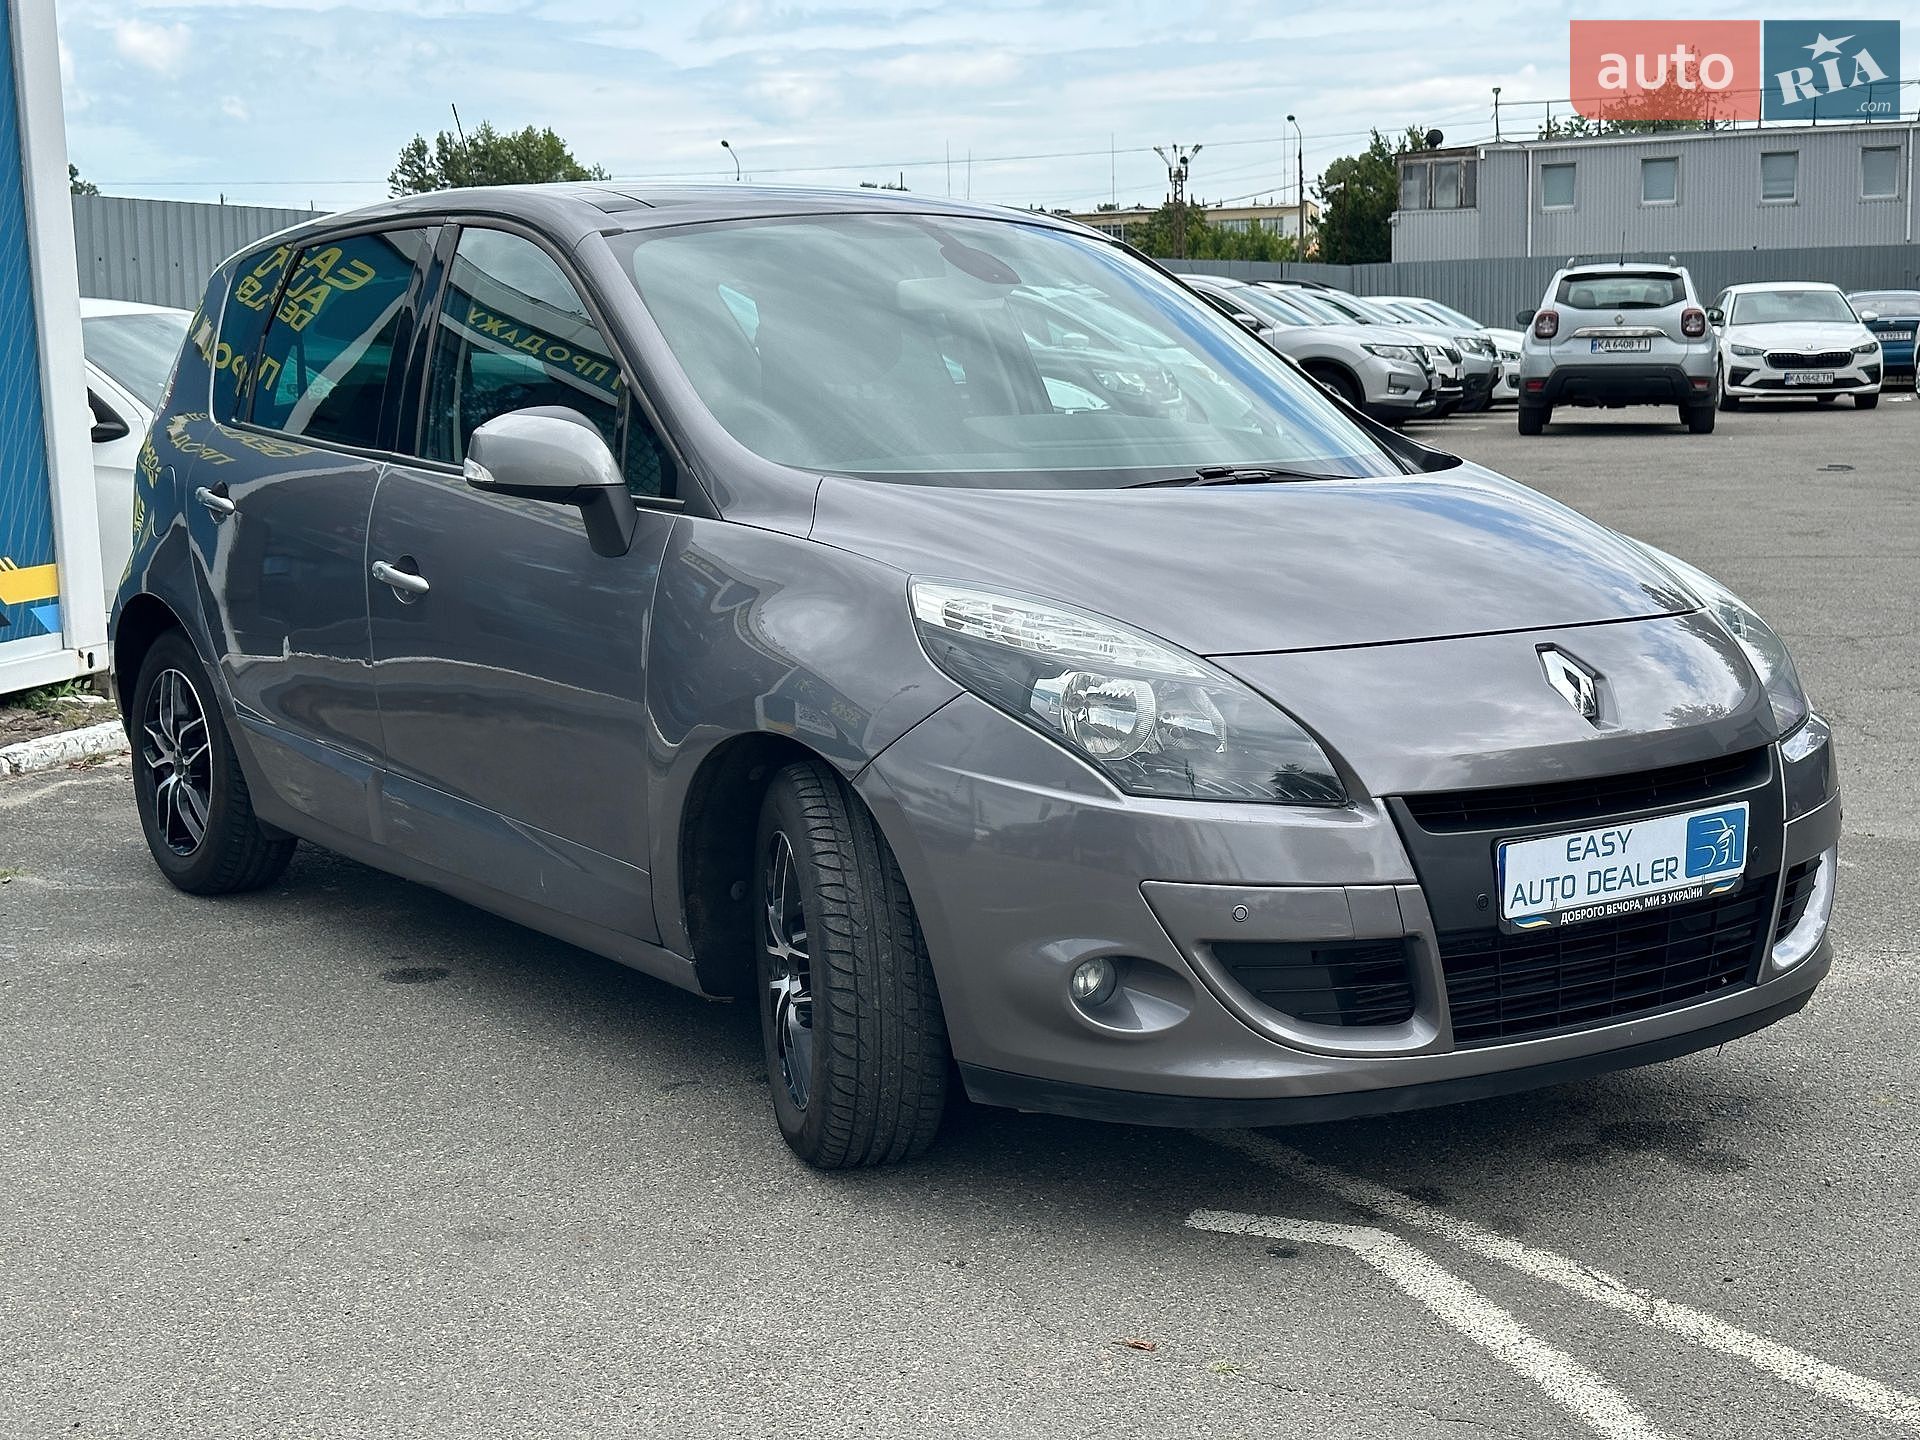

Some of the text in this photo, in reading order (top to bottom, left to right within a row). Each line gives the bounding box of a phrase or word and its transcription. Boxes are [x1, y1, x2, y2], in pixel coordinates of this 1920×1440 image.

[1566, 829, 1633, 862] EASY
[1510, 856, 1679, 909] AUTO DEALER
[1560, 905, 1605, 925] ДОБРОГО
[1606, 899, 1643, 914] ВЕЧОРА,
[1644, 897, 1659, 907] МИ
[1668, 887, 1703, 903] УКРАЇНИ
